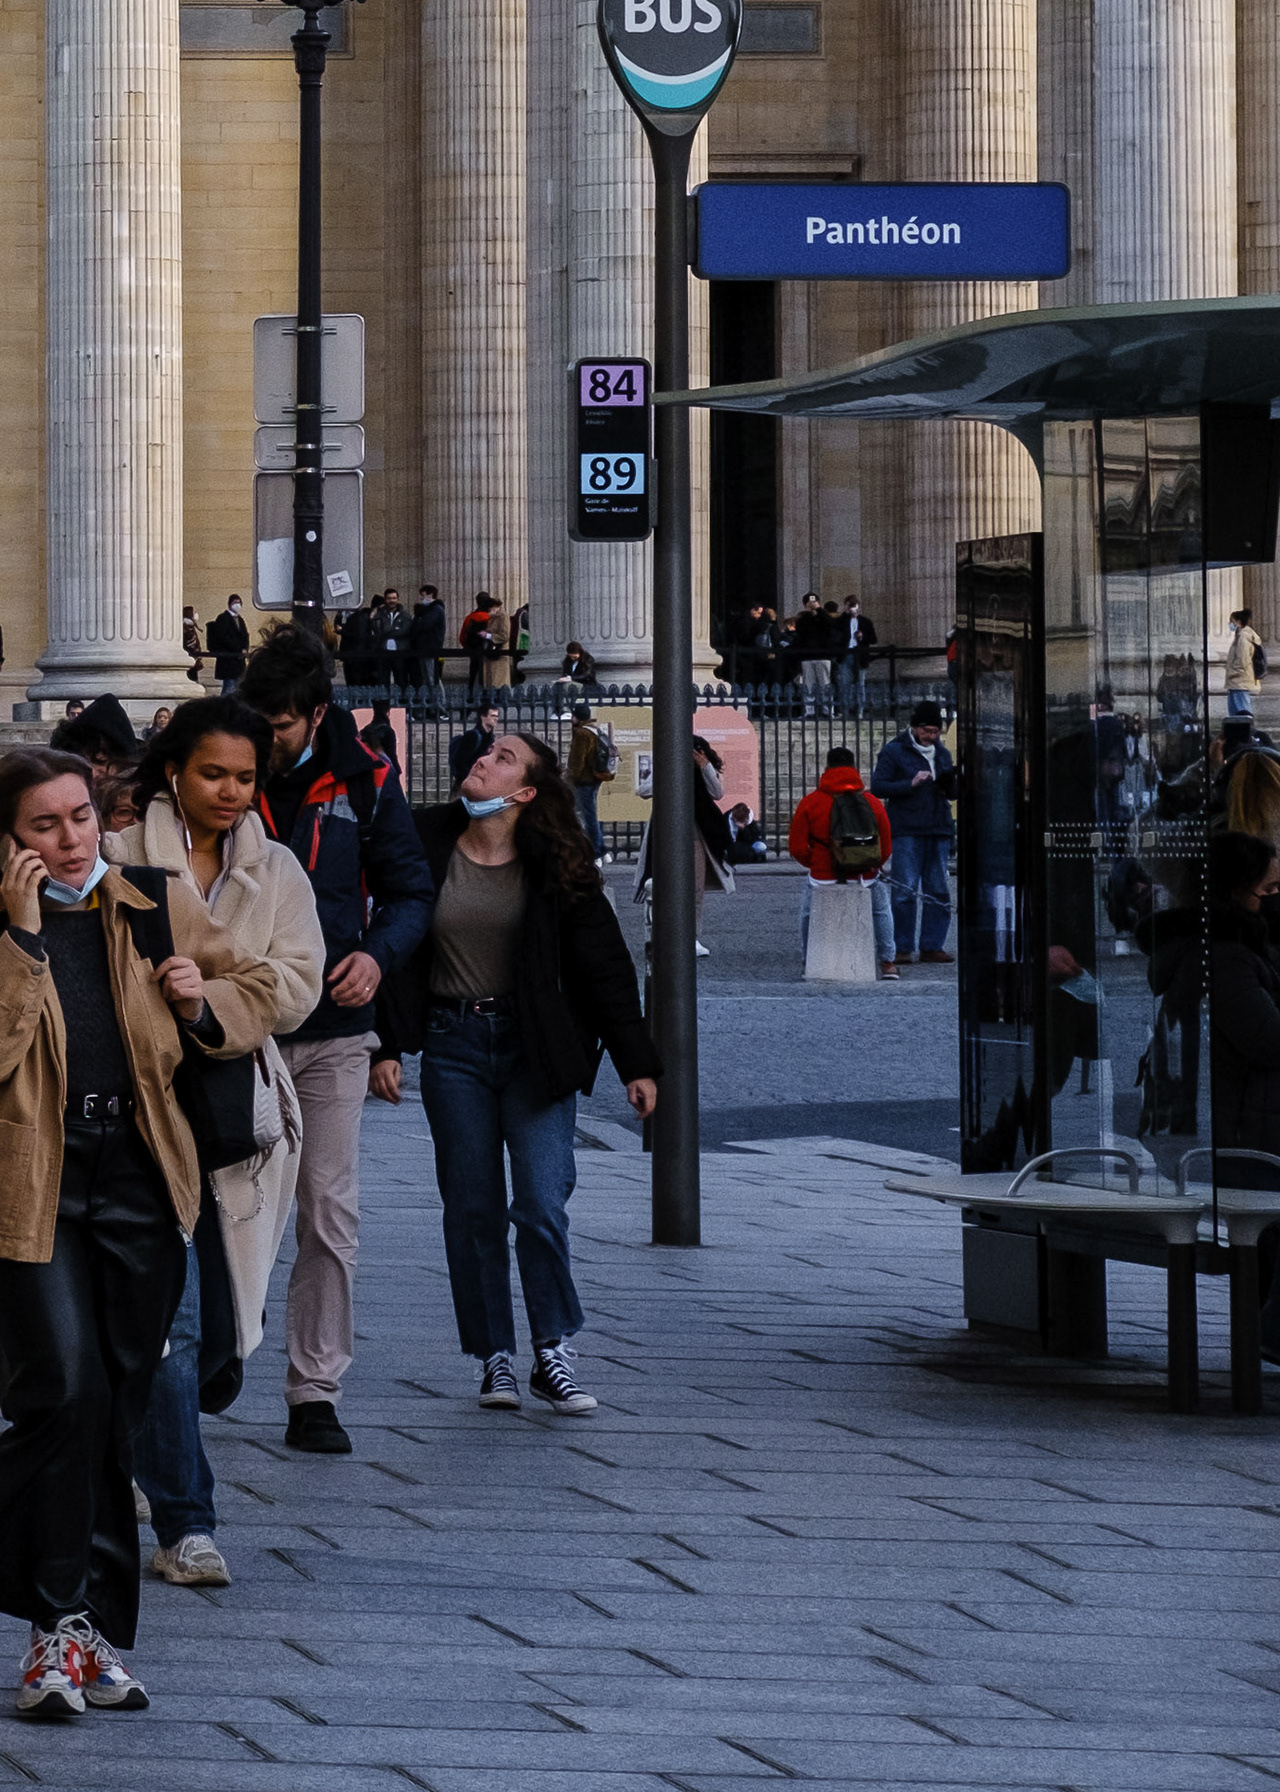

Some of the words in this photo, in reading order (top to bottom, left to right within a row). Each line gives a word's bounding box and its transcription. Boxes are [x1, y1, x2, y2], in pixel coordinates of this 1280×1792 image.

[806, 215, 961, 245] Panthéon
[589, 368, 638, 403] 84
[589, 456, 637, 491] 89
